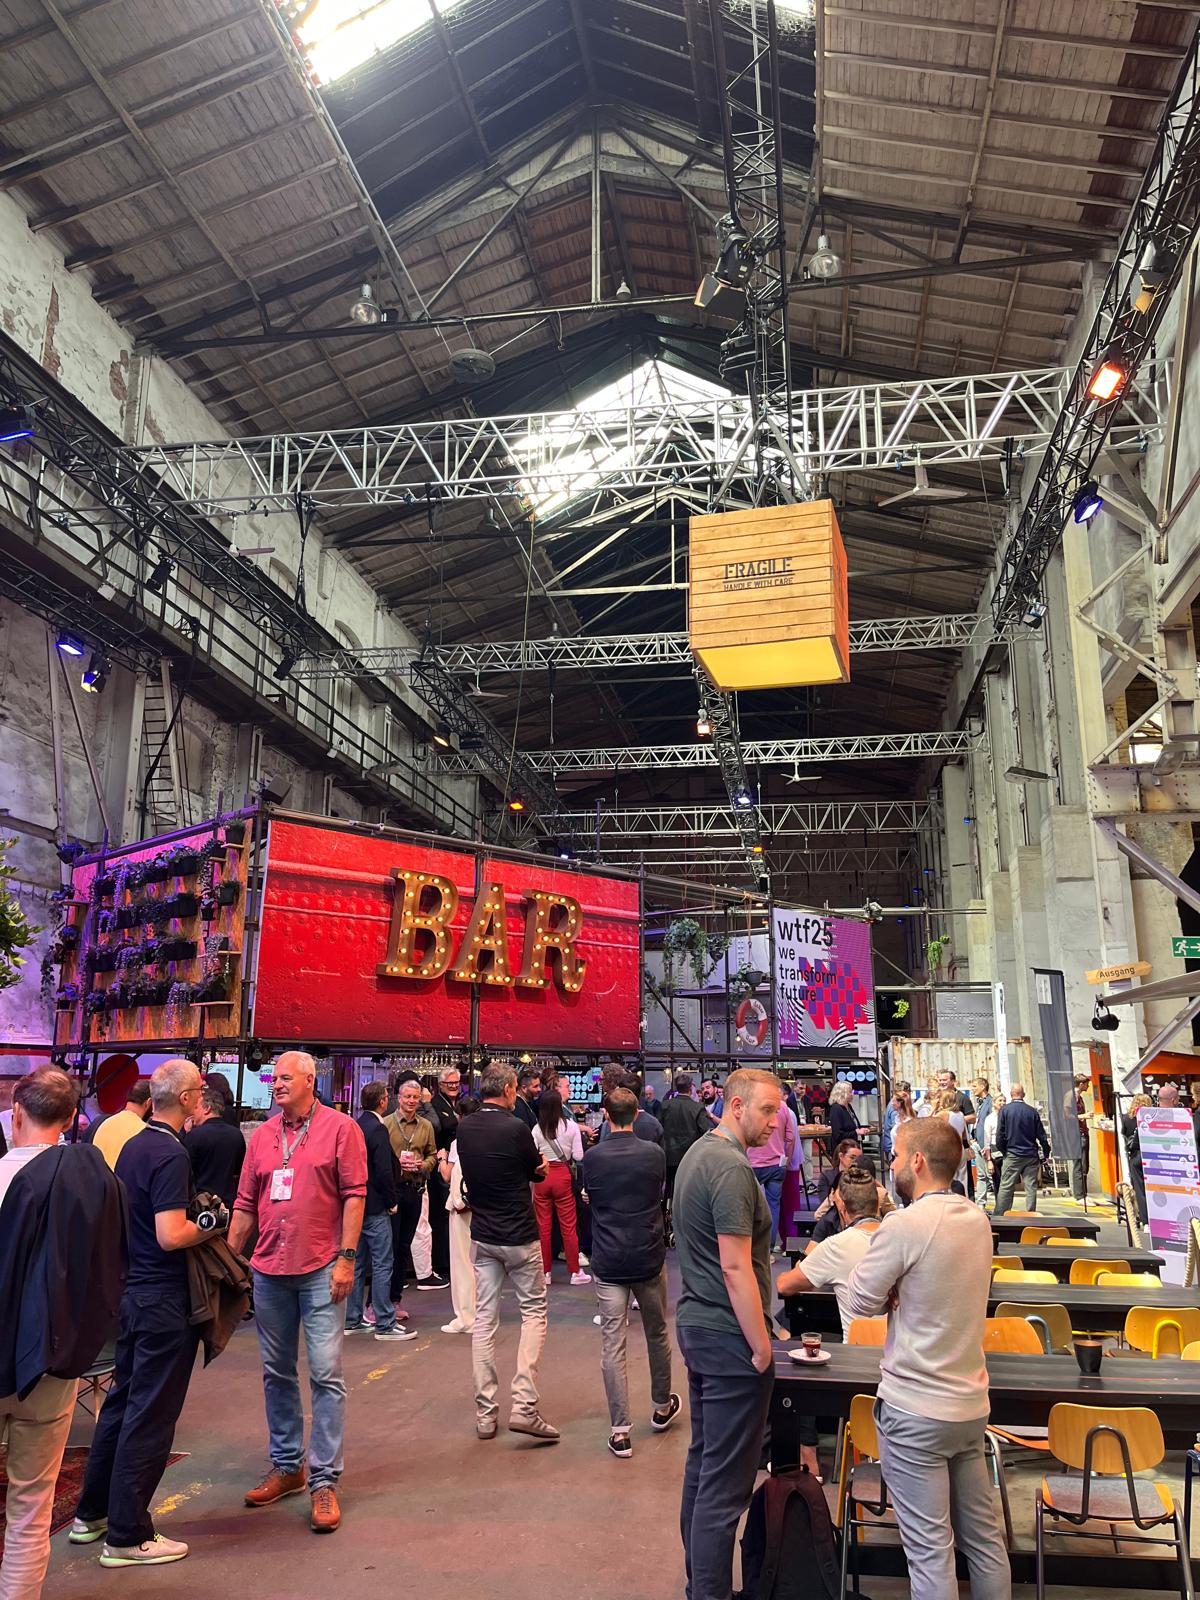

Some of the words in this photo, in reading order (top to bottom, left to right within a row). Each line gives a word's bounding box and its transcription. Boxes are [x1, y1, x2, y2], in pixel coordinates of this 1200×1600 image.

[724, 557, 793, 579] FRAGILE
[723, 581, 753, 591] HANDLE
[754, 579, 773, 588] WITH
[774, 577, 794, 585] CARE
[376, 867, 587, 992] BAR
[777, 917, 833, 947] wtf25
[778, 946, 796, 960] we
[779, 963, 837, 984] transform
[1099, 967, 1136, 978] Ausgang
[779, 983, 816, 1001] future
